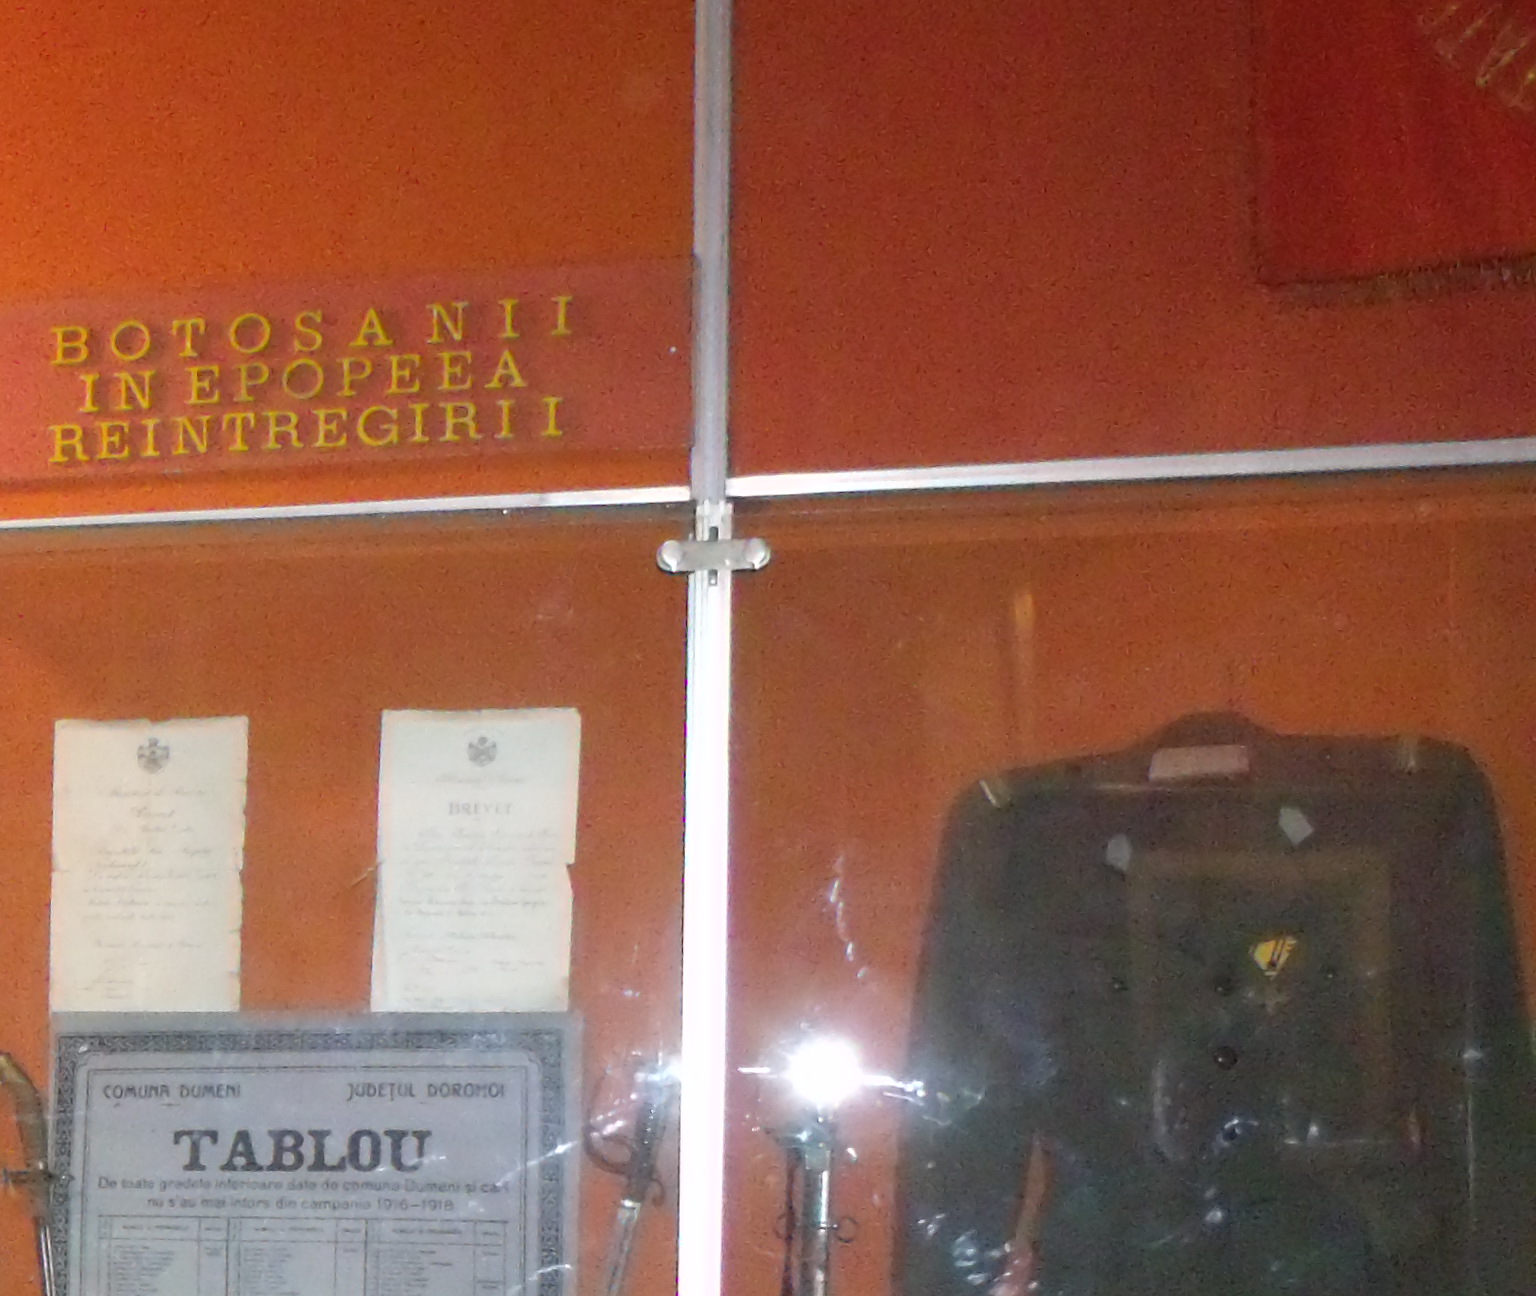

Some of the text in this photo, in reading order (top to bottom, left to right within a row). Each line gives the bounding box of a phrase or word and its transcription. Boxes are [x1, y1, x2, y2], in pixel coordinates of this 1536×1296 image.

[49, 295, 573, 366] BOTOSANII
[78, 350, 527, 413] IN EPOPEEA
[47, 396, 565, 464] REINTREGIRII
[103, 1083, 241, 1100] COMUNA DUMENI
[173, 1128, 433, 1173] TABLOU
[97, 1177, 118, 1190] De
